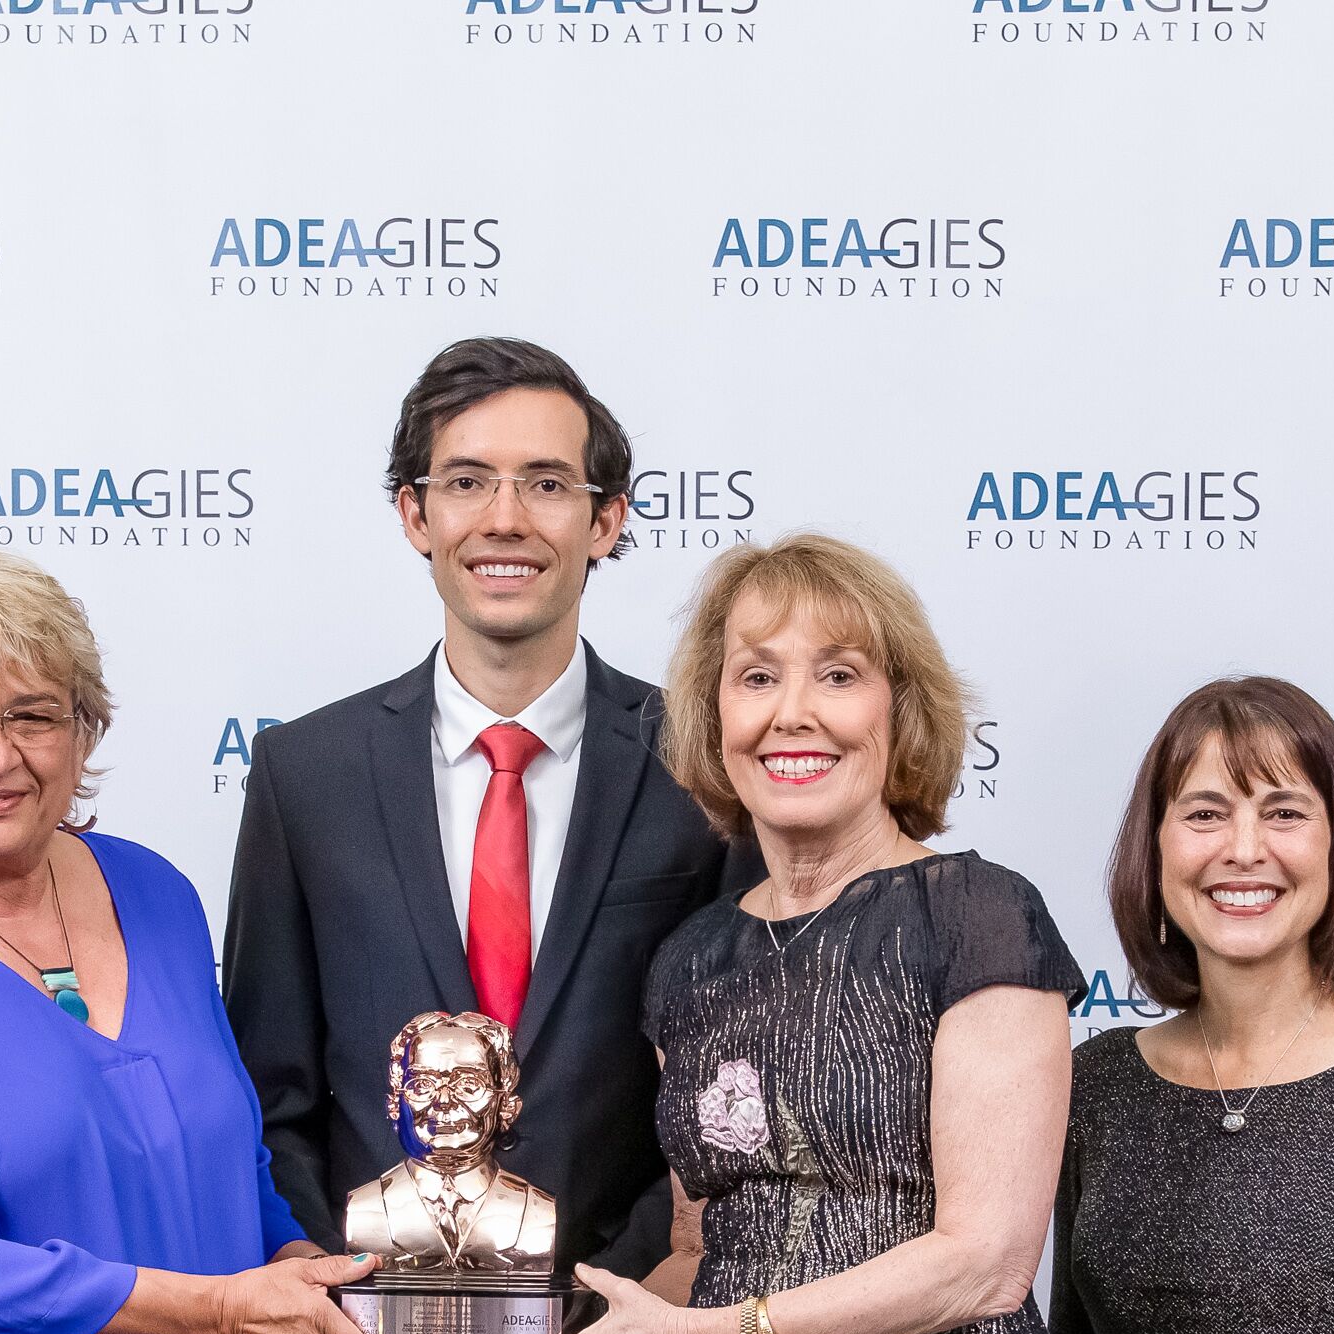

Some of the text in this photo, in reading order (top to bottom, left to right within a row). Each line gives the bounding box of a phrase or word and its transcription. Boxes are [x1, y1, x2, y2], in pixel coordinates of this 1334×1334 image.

[466, 23, 755, 44] FOUNDATION
[972, 22, 1266, 43] FOUNDATION
[211, 277, 498, 297] FOUNDATION
[712, 277, 1002, 298] FOUNDATION
[627, 529, 752, 548] ATION
[966, 530, 1257, 550] FOUNDATION
[360, 1320, 377, 1328] GIES
